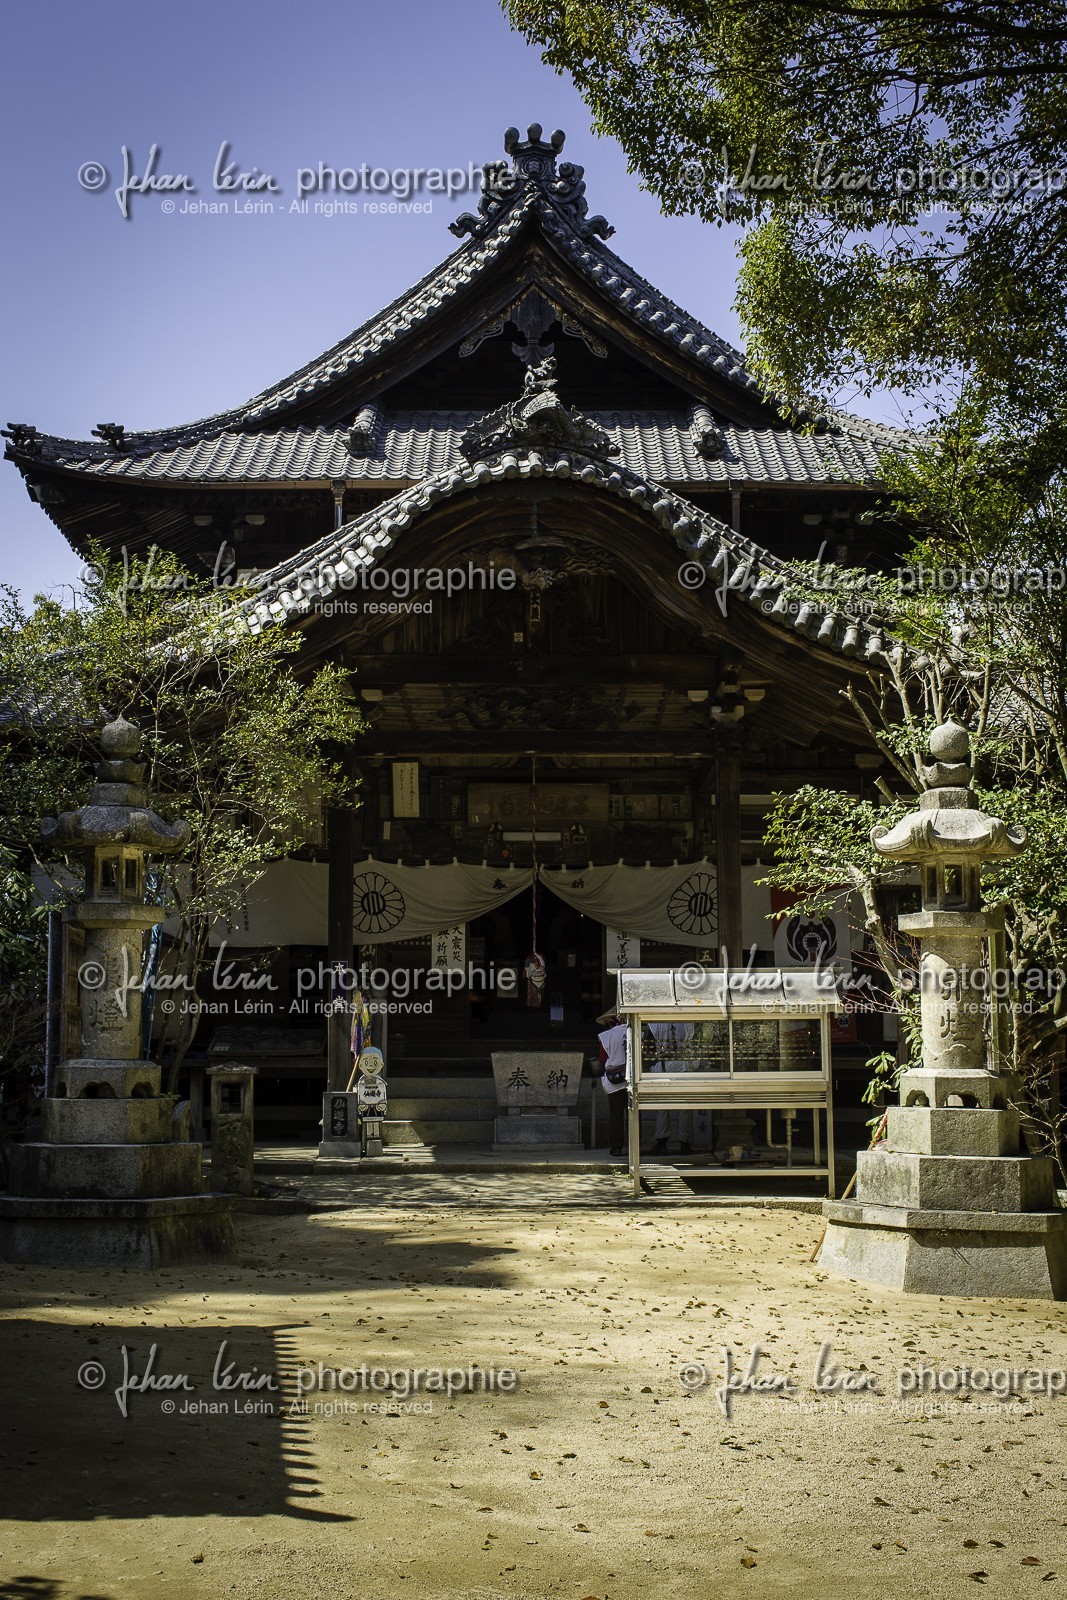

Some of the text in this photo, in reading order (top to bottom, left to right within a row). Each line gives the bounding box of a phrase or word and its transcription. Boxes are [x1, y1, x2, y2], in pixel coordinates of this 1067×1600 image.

[452, 926, 464, 962] 大震災
[505, 1066, 569, 1091] 奉納
